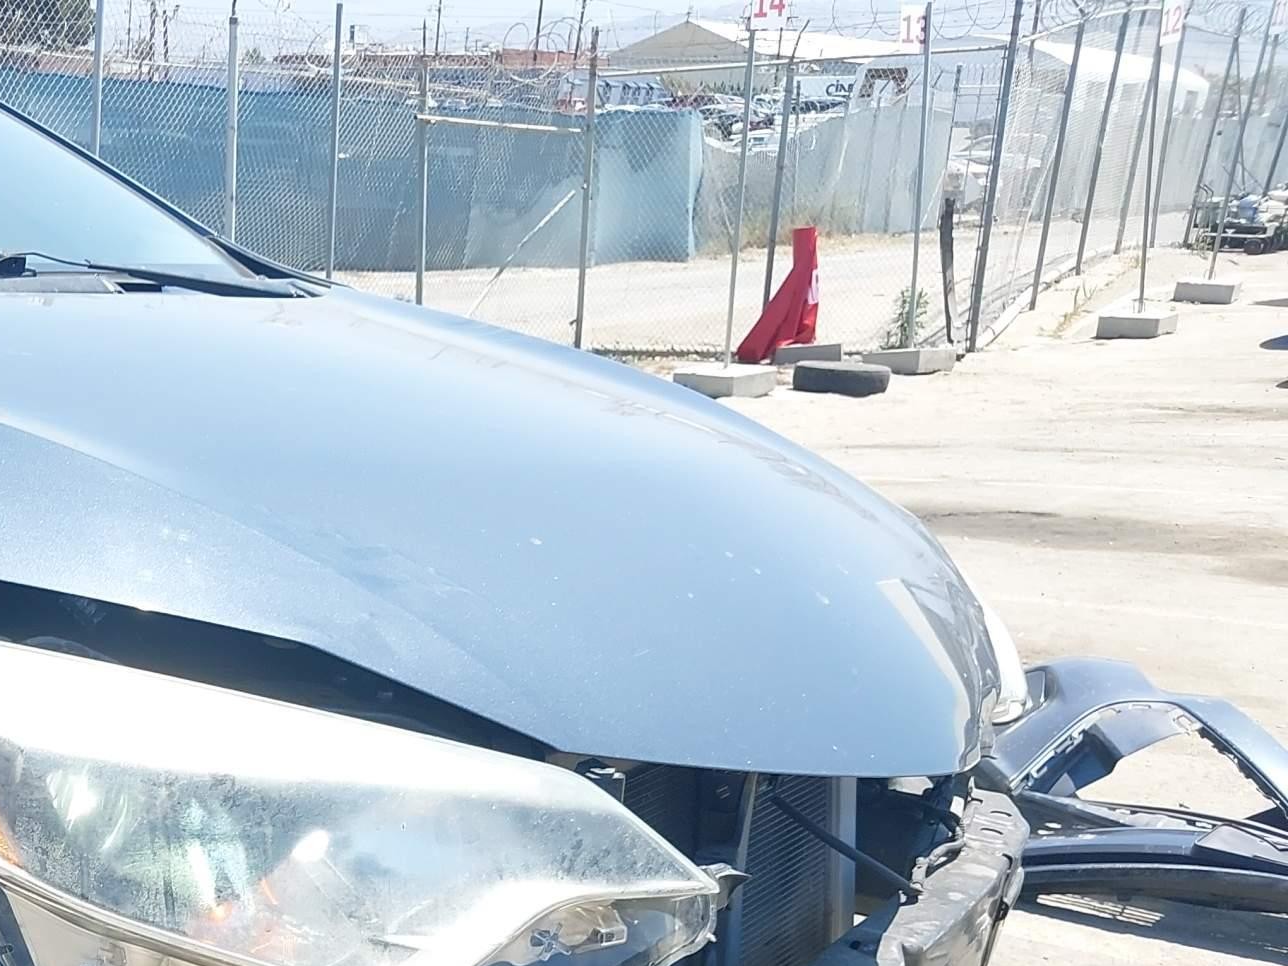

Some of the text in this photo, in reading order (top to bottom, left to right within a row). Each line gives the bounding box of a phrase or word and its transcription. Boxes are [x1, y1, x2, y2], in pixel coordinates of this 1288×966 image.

[753, 0, 786, 18] 14
[1162, 5, 1182, 36] 12
[902, 14, 927, 45] 13
